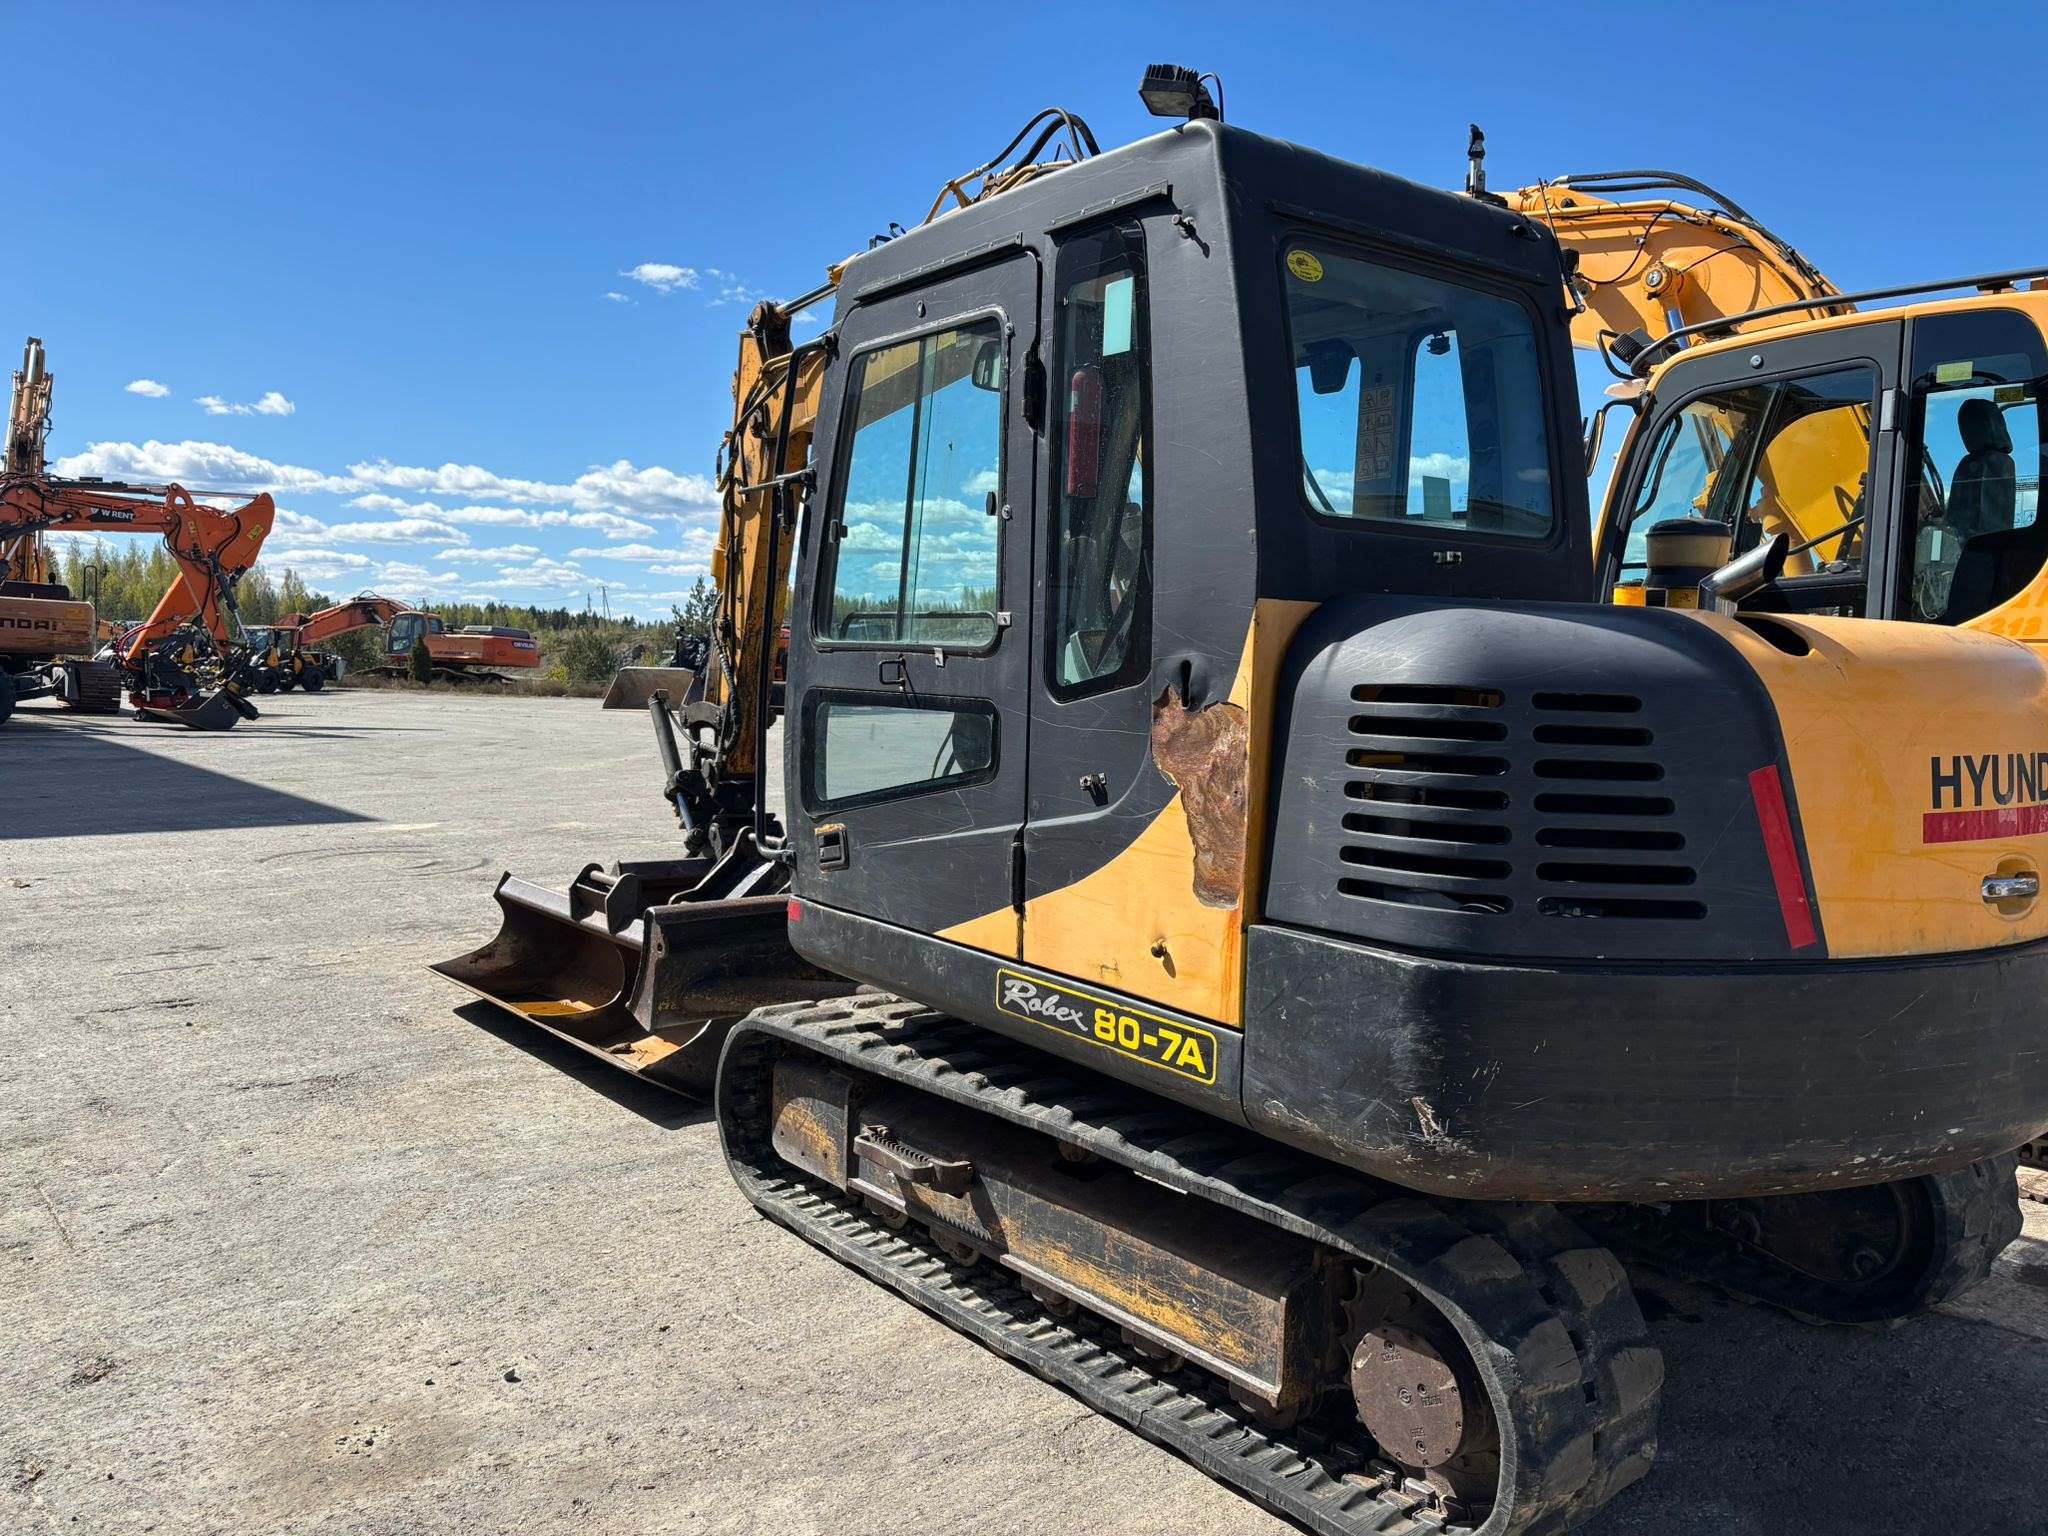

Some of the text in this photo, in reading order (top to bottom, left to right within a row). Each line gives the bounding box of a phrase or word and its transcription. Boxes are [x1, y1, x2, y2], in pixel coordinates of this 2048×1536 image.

[112, 510, 134, 520] RENT
[1931, 752, 2048, 809] HYUND
[1003, 979, 1206, 1074] Robex 80-7A
